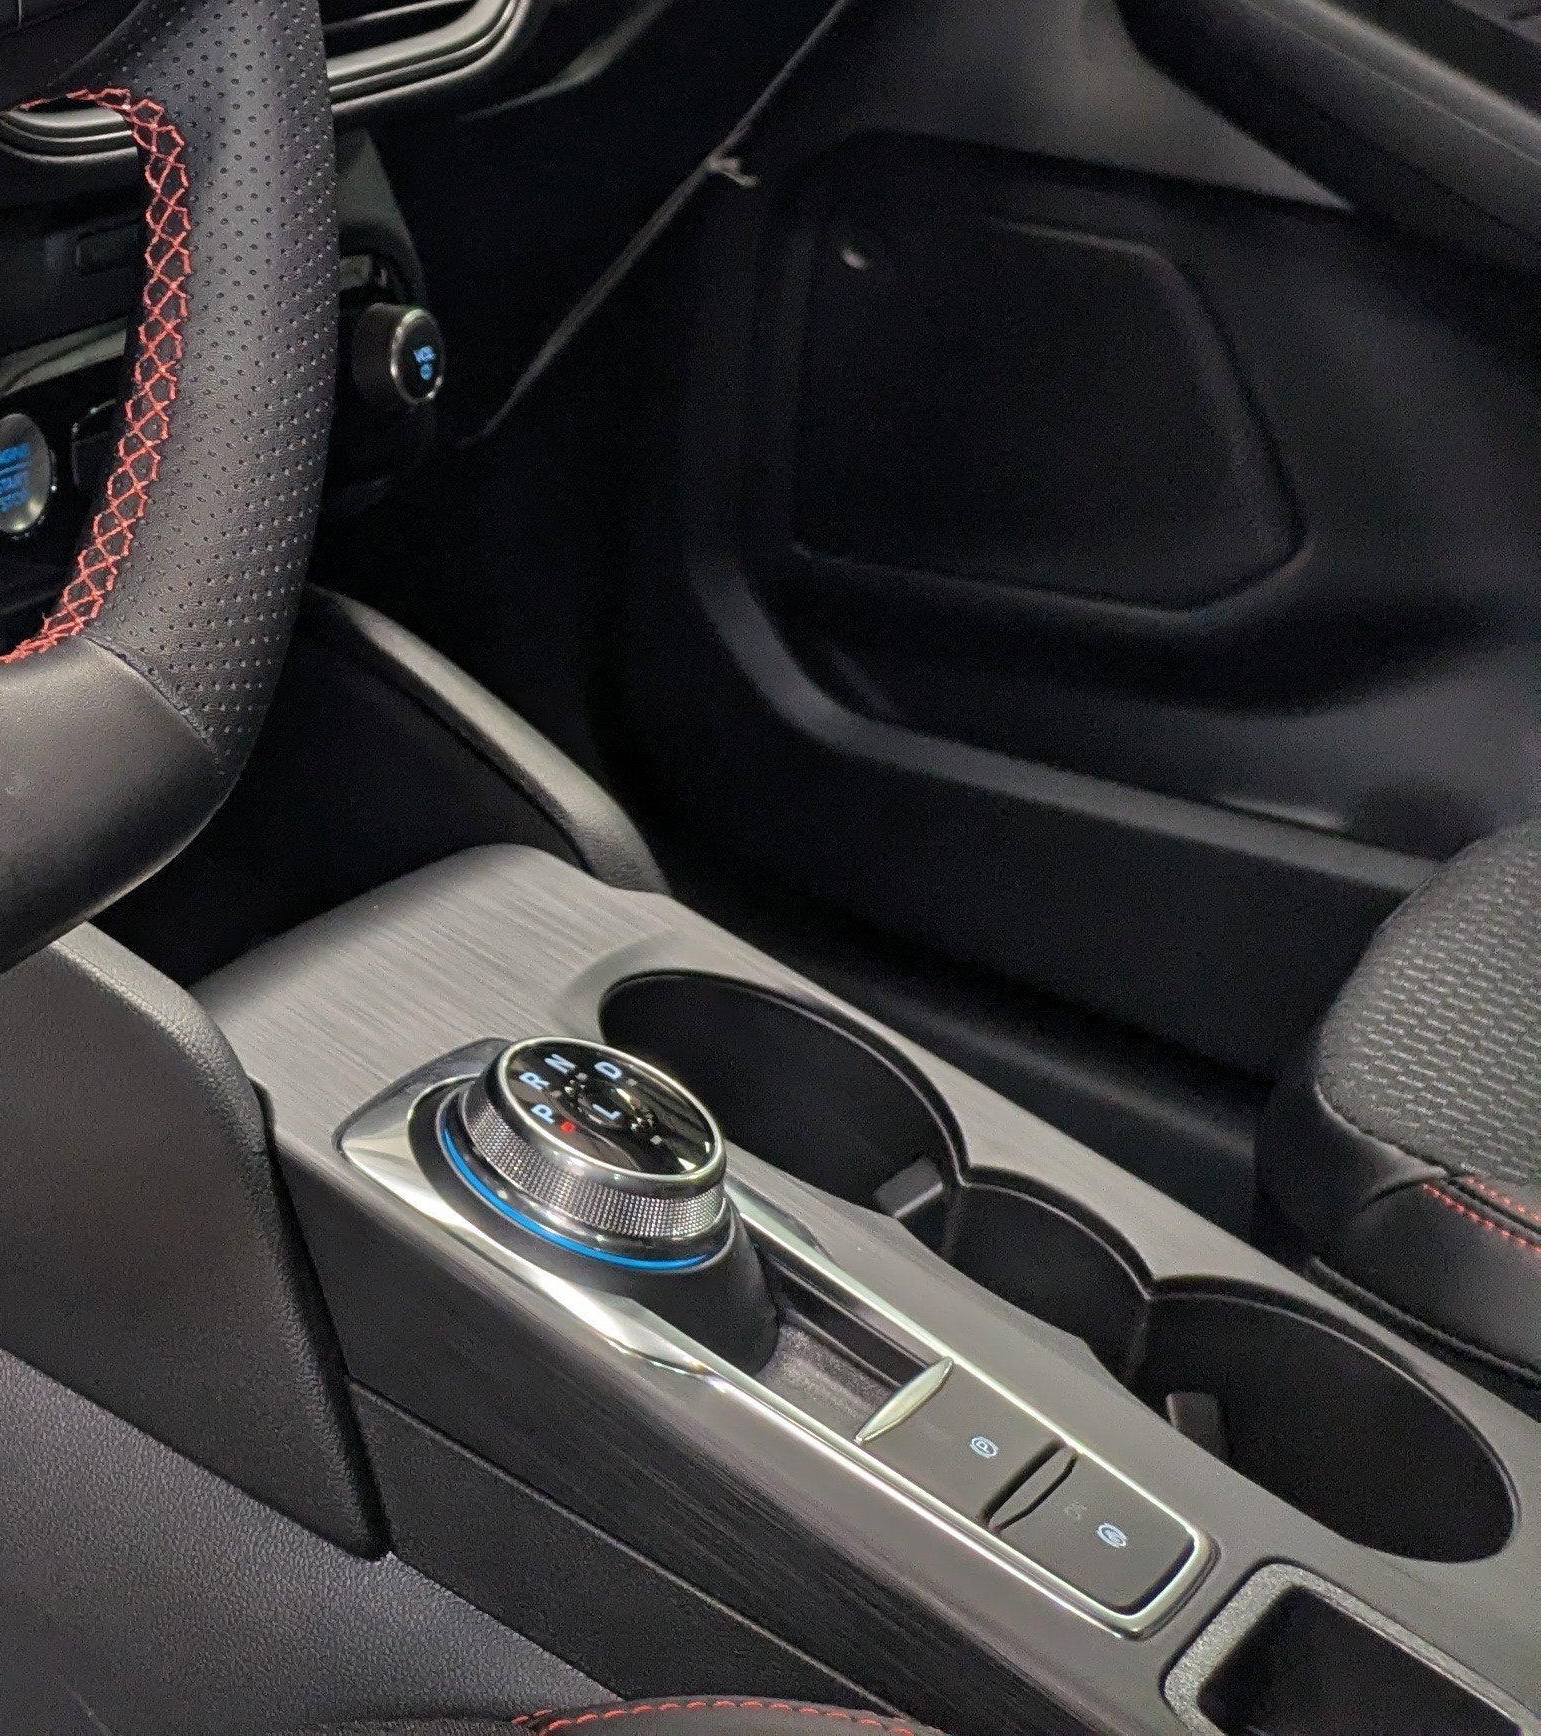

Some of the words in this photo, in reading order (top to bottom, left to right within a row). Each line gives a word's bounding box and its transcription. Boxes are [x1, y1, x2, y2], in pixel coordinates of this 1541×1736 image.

[544, 1053, 576, 1075] N
[594, 1061, 623, 1080] D
[519, 1071, 550, 1092] R
[530, 1103, 555, 1124] P
[592, 1103, 621, 1121] L
